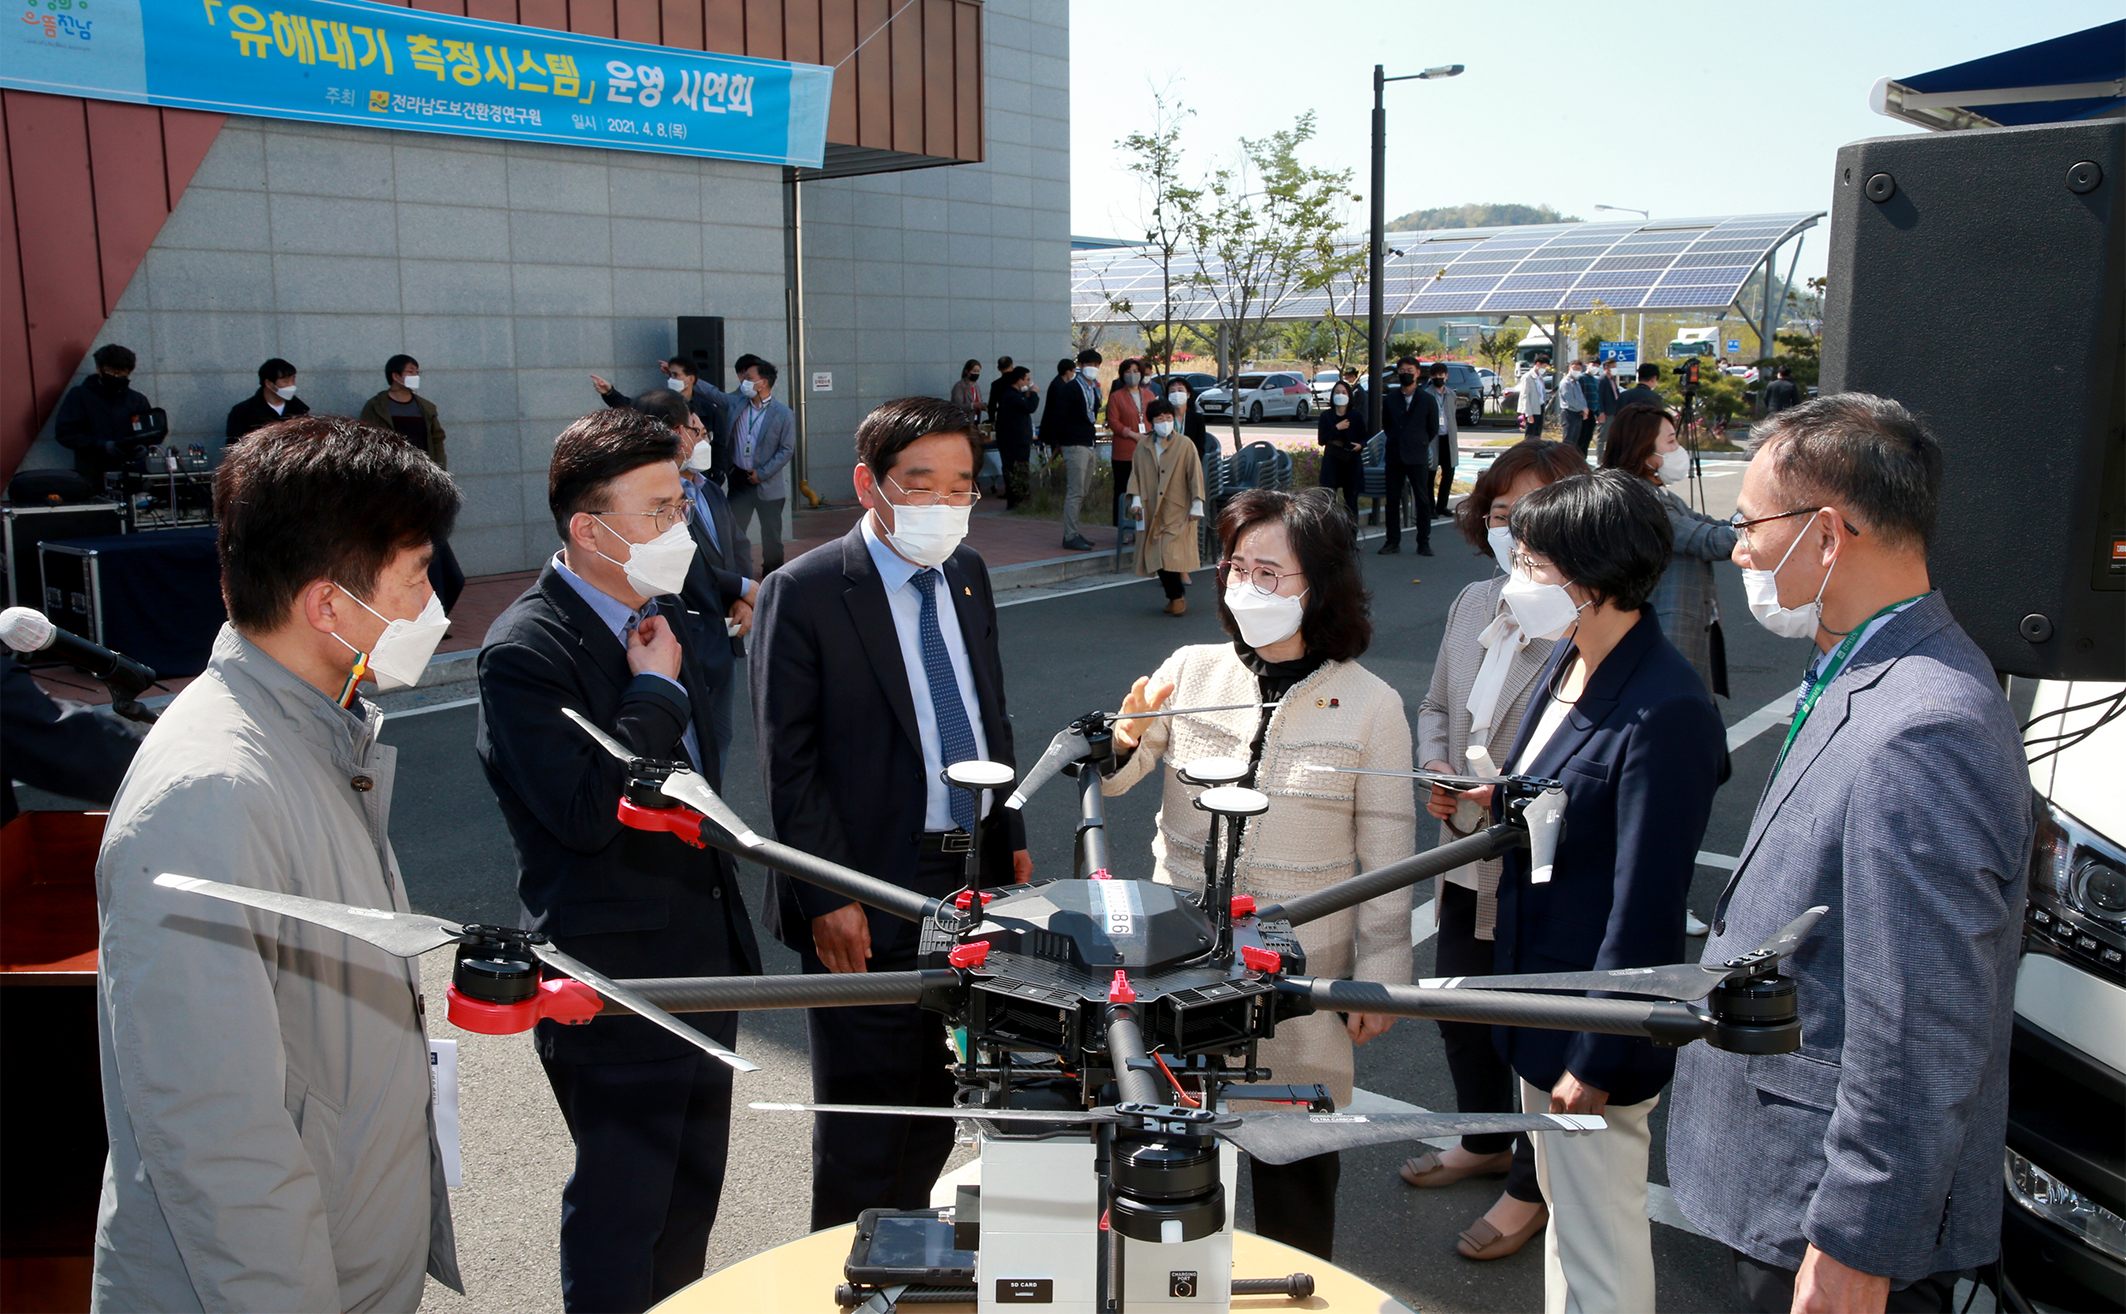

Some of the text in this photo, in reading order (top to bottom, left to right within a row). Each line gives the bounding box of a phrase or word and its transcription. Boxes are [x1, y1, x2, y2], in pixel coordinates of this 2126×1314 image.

[407, 34, 595, 105] 측정시스템」
[606, 60, 665, 108] 운영
[673, 69, 755, 117] 시연회
[325, 87, 542, 127] 주최 전라남도보건환경연구원
[571, 114, 597, 132] 일시
[607, 118, 638, 136] 2021.
